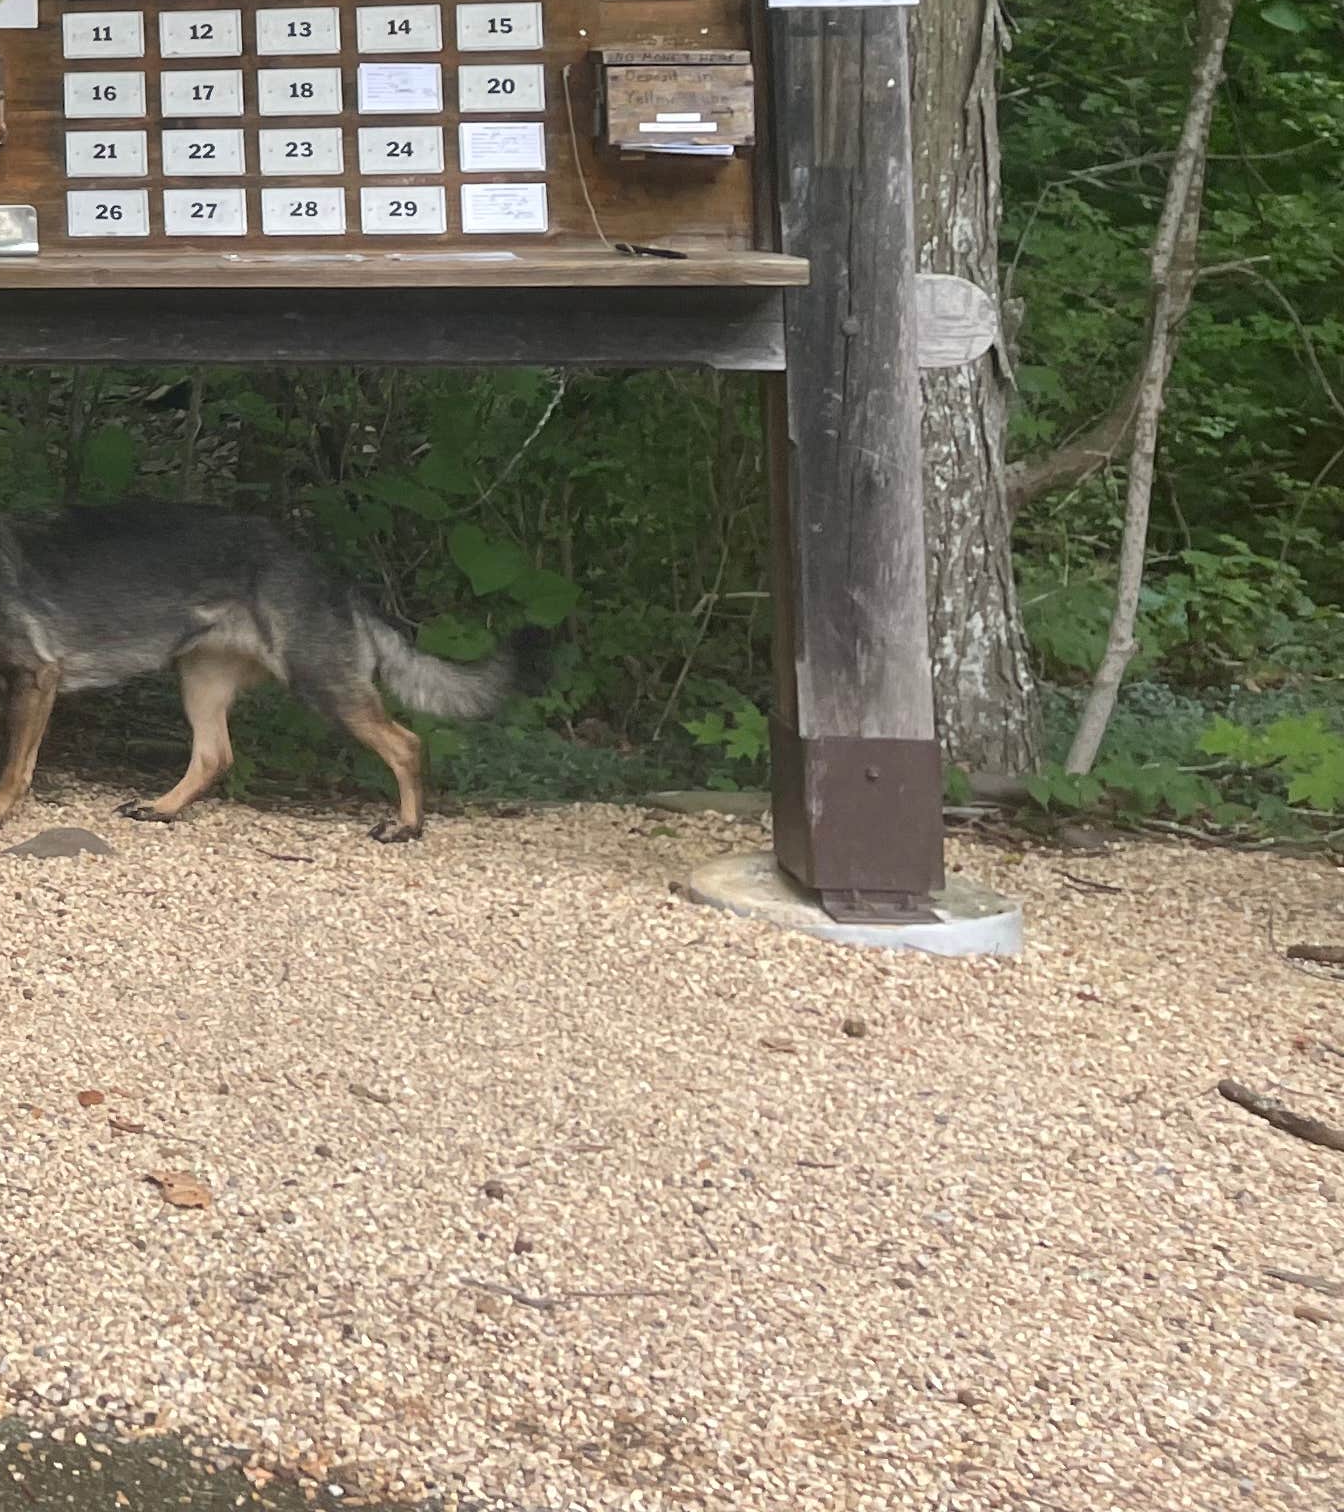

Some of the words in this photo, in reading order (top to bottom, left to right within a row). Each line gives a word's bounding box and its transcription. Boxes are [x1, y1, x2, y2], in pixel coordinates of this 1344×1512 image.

[189, 24, 213, 40] 12
[287, 21, 312, 37] 13
[387, 19, 412, 35] 14
[487, 18, 513, 33] 15
[92, 26, 113, 42] 11
[91, 85, 117, 101] 16
[192, 85, 215, 101] 17
[289, 82, 314, 98] 18
[487, 78, 515, 94] 20
[93, 143, 117, 159] 21
[188, 143, 216, 159] 22
[285, 141, 313, 157] 23
[386, 141, 414, 157] 24
[95, 204, 123, 220] 26
[190, 203, 218, 218] 27
[289, 201, 318, 217] 28
[388, 201, 418, 217] 29
